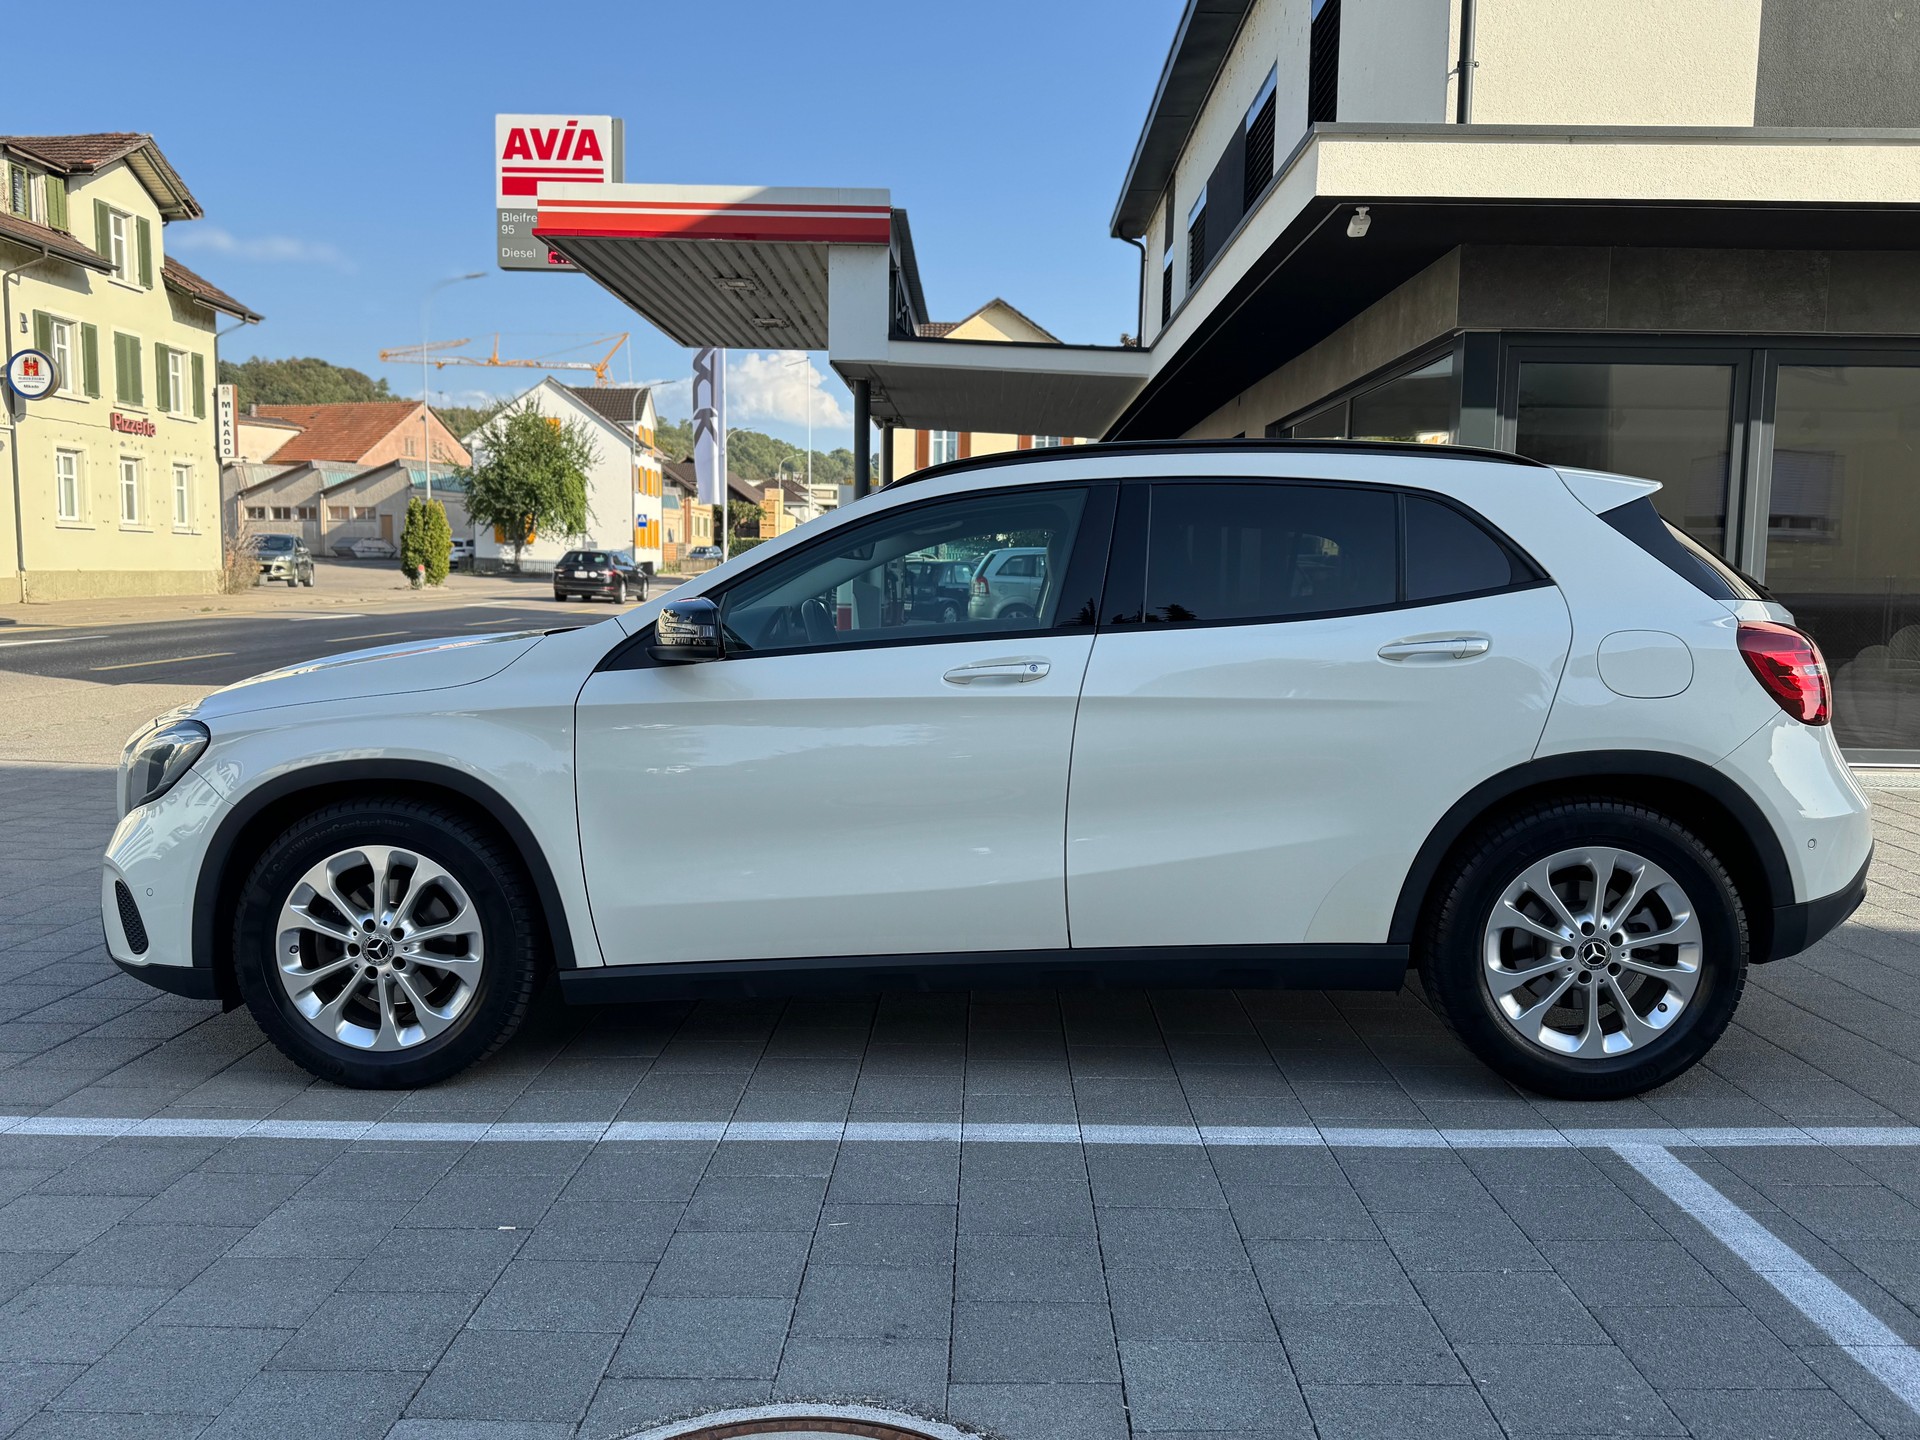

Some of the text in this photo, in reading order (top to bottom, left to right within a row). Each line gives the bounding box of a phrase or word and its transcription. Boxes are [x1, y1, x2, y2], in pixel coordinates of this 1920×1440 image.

[501, 212, 538, 223] Bleifre
[501, 224, 515, 235] 95
[501, 247, 536, 258] Diesel
[111, 412, 156, 436] Pizzeria
[221, 401, 231, 455] MIKADO
